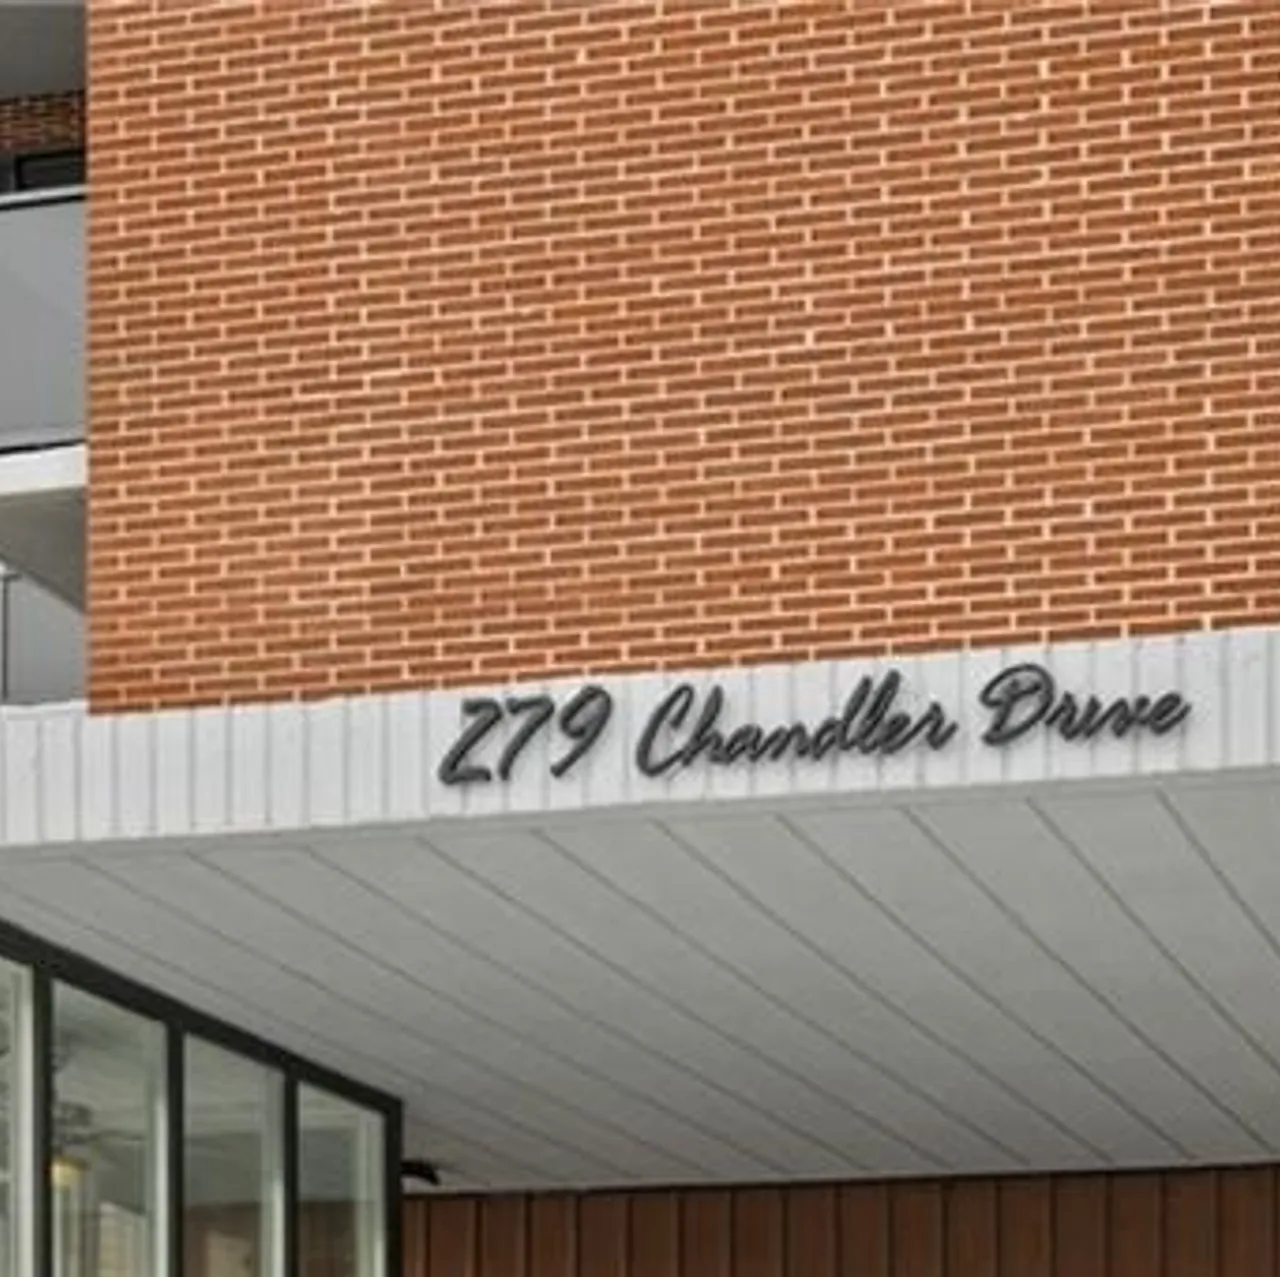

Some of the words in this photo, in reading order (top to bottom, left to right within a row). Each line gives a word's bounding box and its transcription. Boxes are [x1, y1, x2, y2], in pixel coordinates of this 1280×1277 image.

[438, 685, 614, 786] 279
[635, 669, 960, 778] Chandler
[978, 662, 1192, 748] Drive
